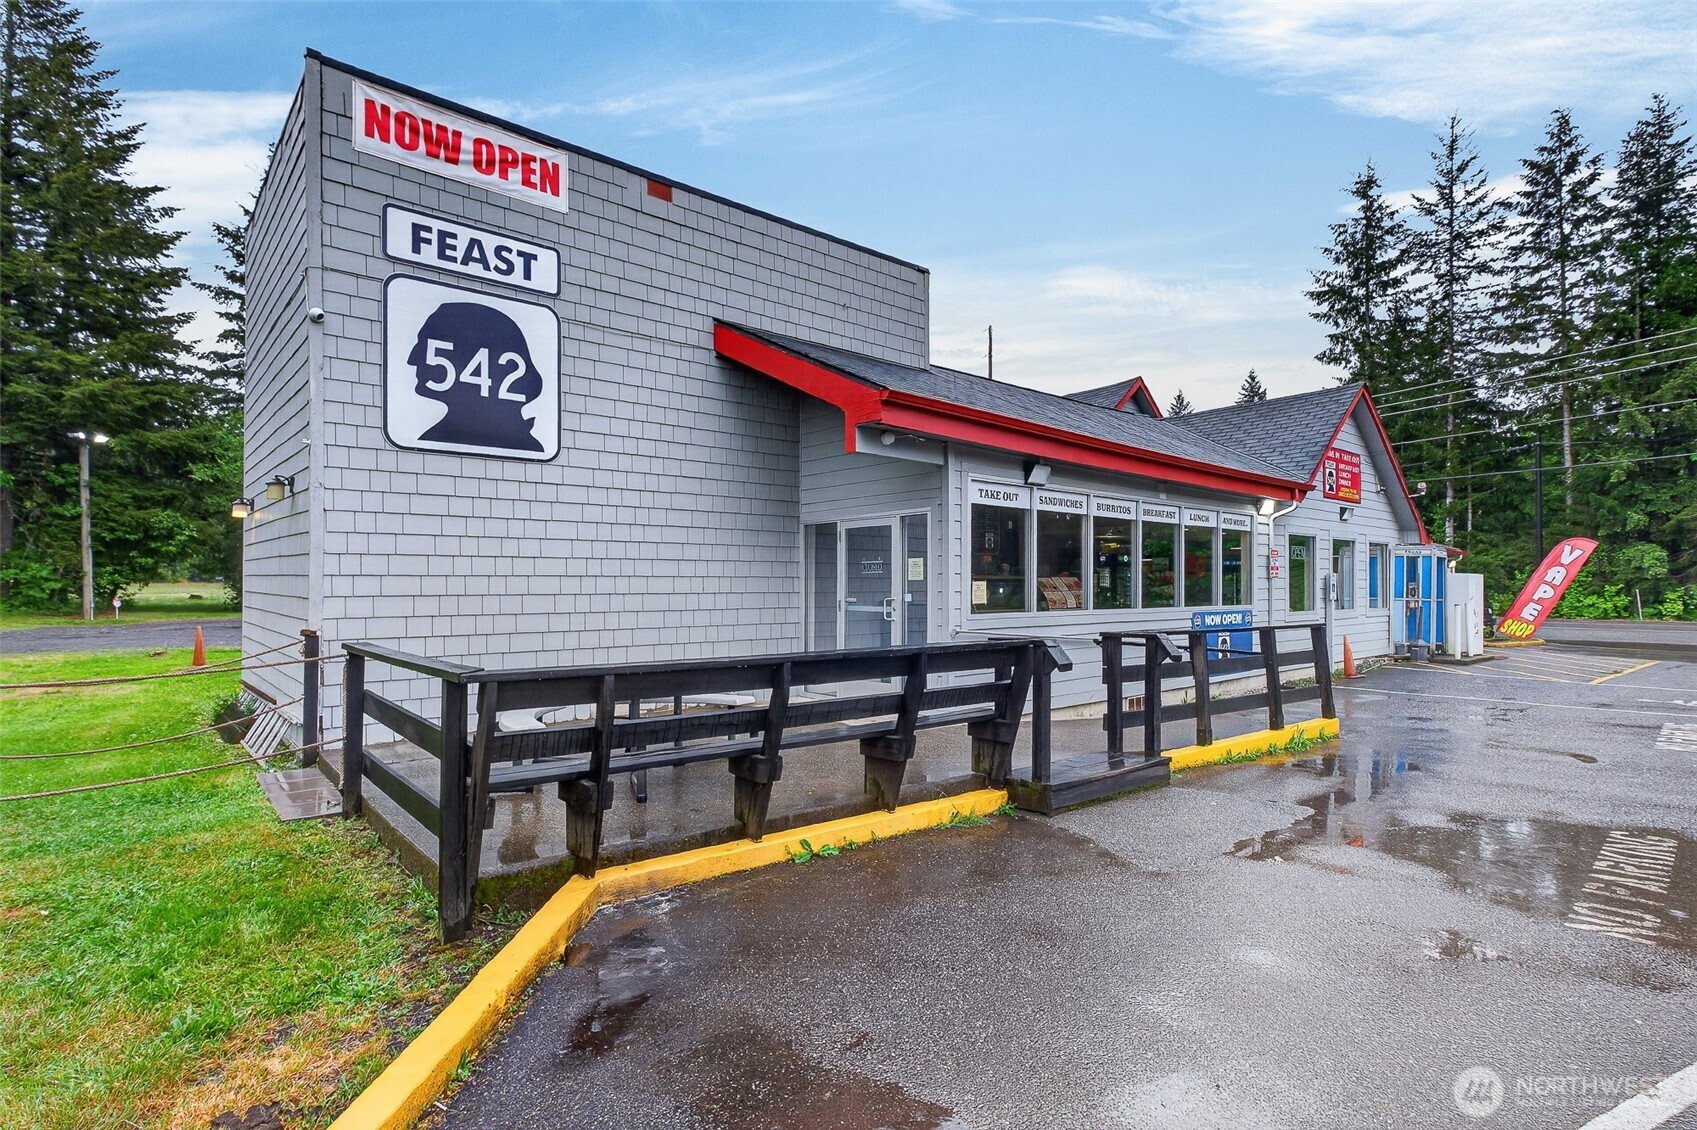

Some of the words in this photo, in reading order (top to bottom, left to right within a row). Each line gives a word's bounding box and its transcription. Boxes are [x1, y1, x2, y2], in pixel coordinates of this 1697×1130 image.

[364, 98, 463, 166] NOW
[472, 137, 560, 198] OPEN
[411, 222, 538, 281] FEAST
[425, 338, 527, 402] 542
[978, 488, 1000, 501] TAKE
[1003, 491, 1019, 502] OUT
[1039, 495, 1083, 510] SANDWICHES
[1096, 502, 1132, 514] BURRITOS
[1142, 508, 1177, 520] BREAKFAST
[1189, 513, 1209, 523] LUNCH
[1223, 517, 1232, 525] AND
[1520, 544, 1584, 622] VAPE
[1205, 615, 1221, 626] NOW
[1222, 613, 1243, 624] OPEN!
[1500, 618, 1536, 638] SHOP
